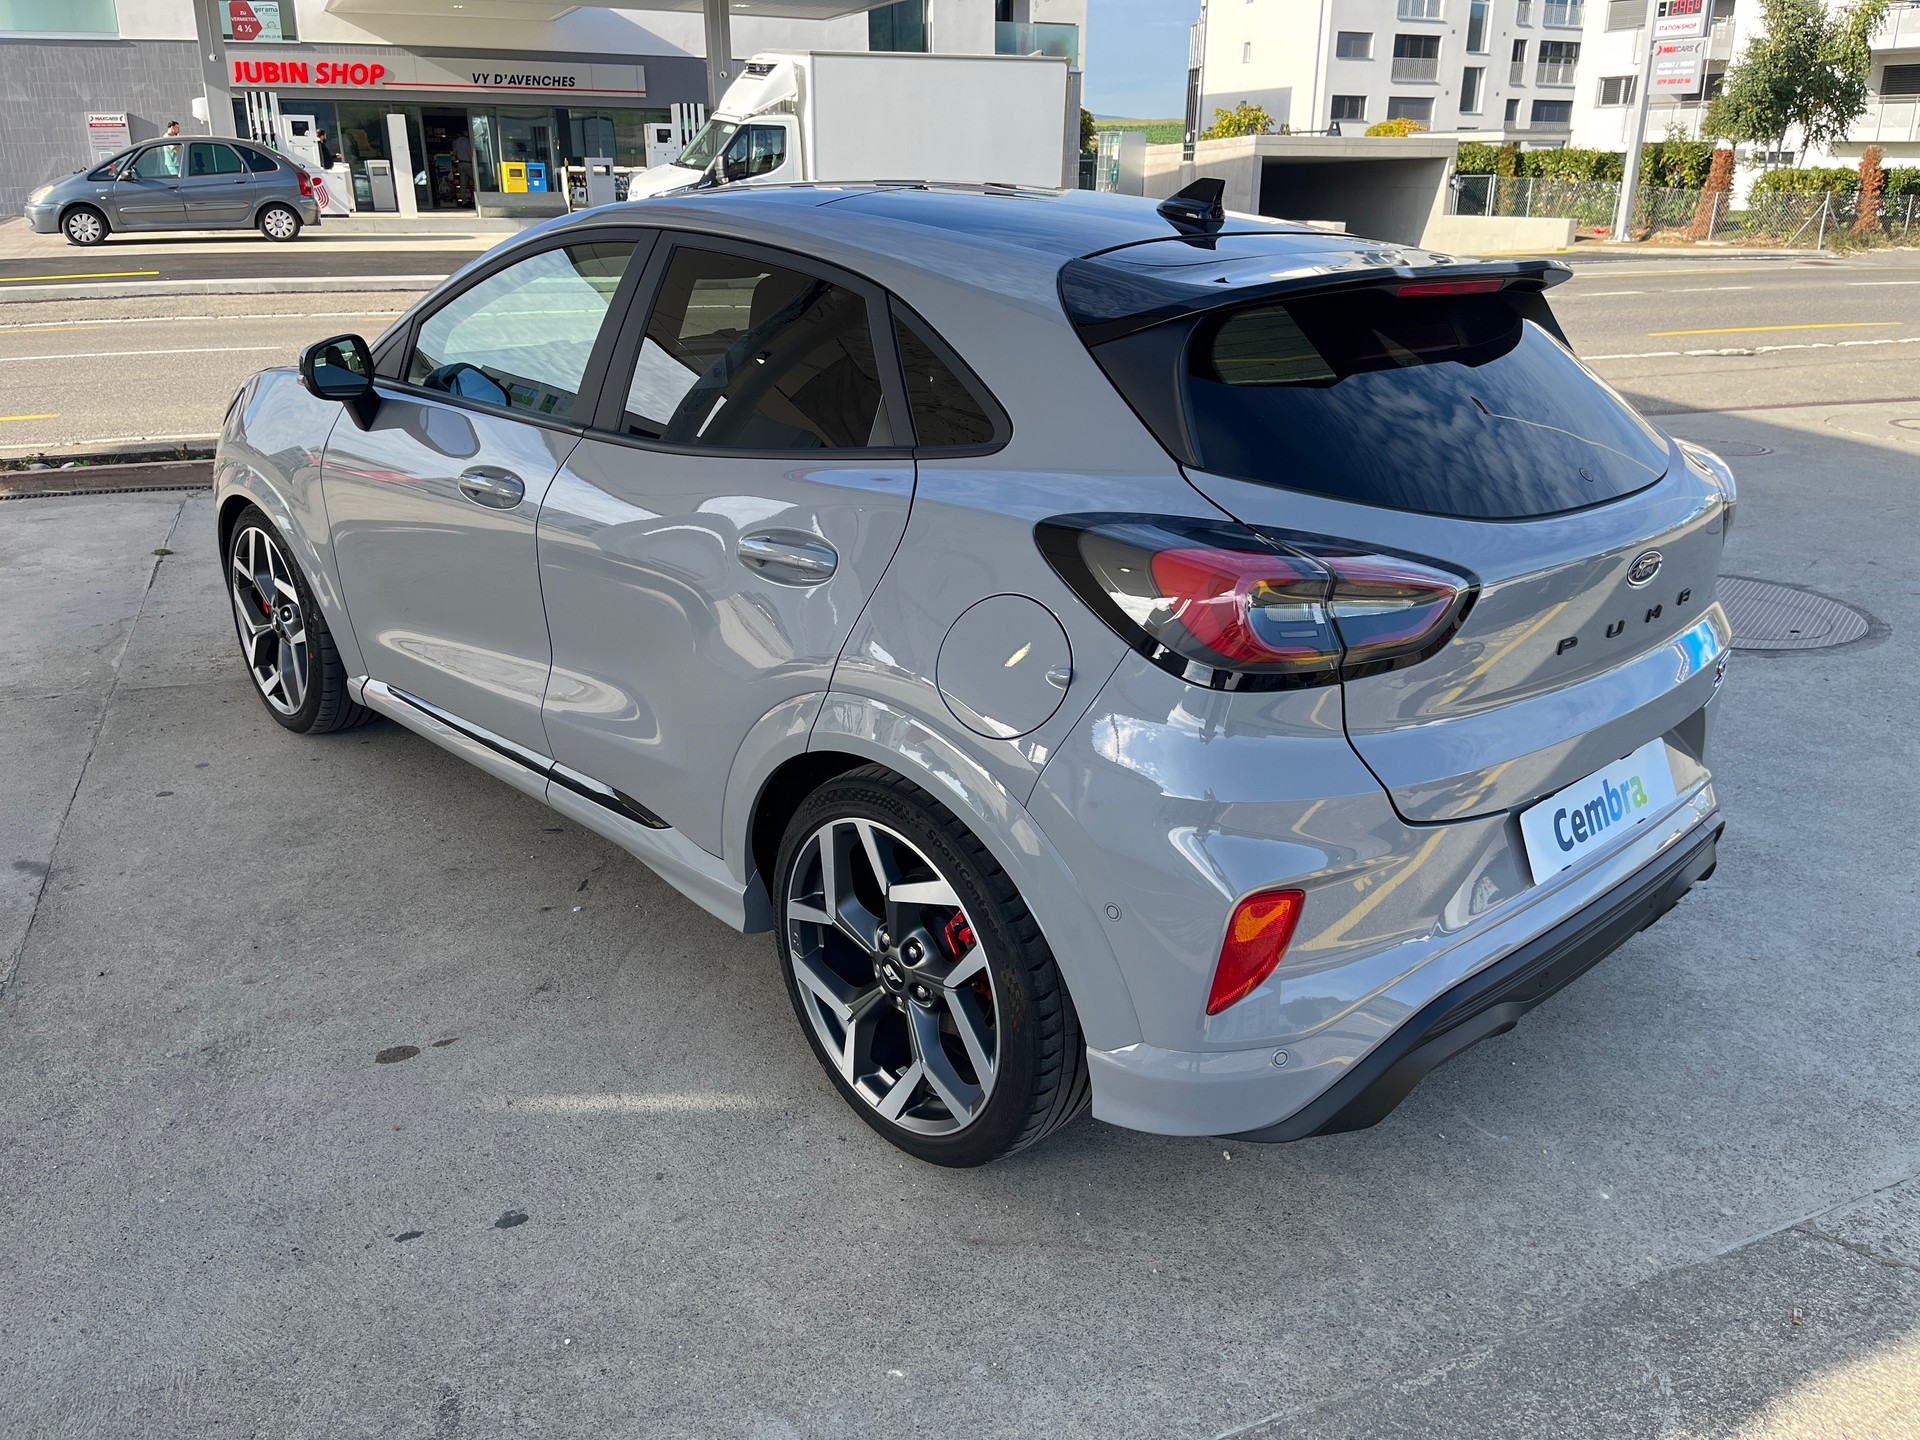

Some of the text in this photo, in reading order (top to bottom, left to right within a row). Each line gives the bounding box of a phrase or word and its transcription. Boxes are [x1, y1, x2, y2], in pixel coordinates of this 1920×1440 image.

[1663, 44, 1694, 53] MAXCARS
[235, 61, 385, 85] JUBIN SHOP
[472, 73, 490, 84] VY
[1556, 588, 1692, 656] PUMA
[1553, 775, 1648, 852] Cembra
